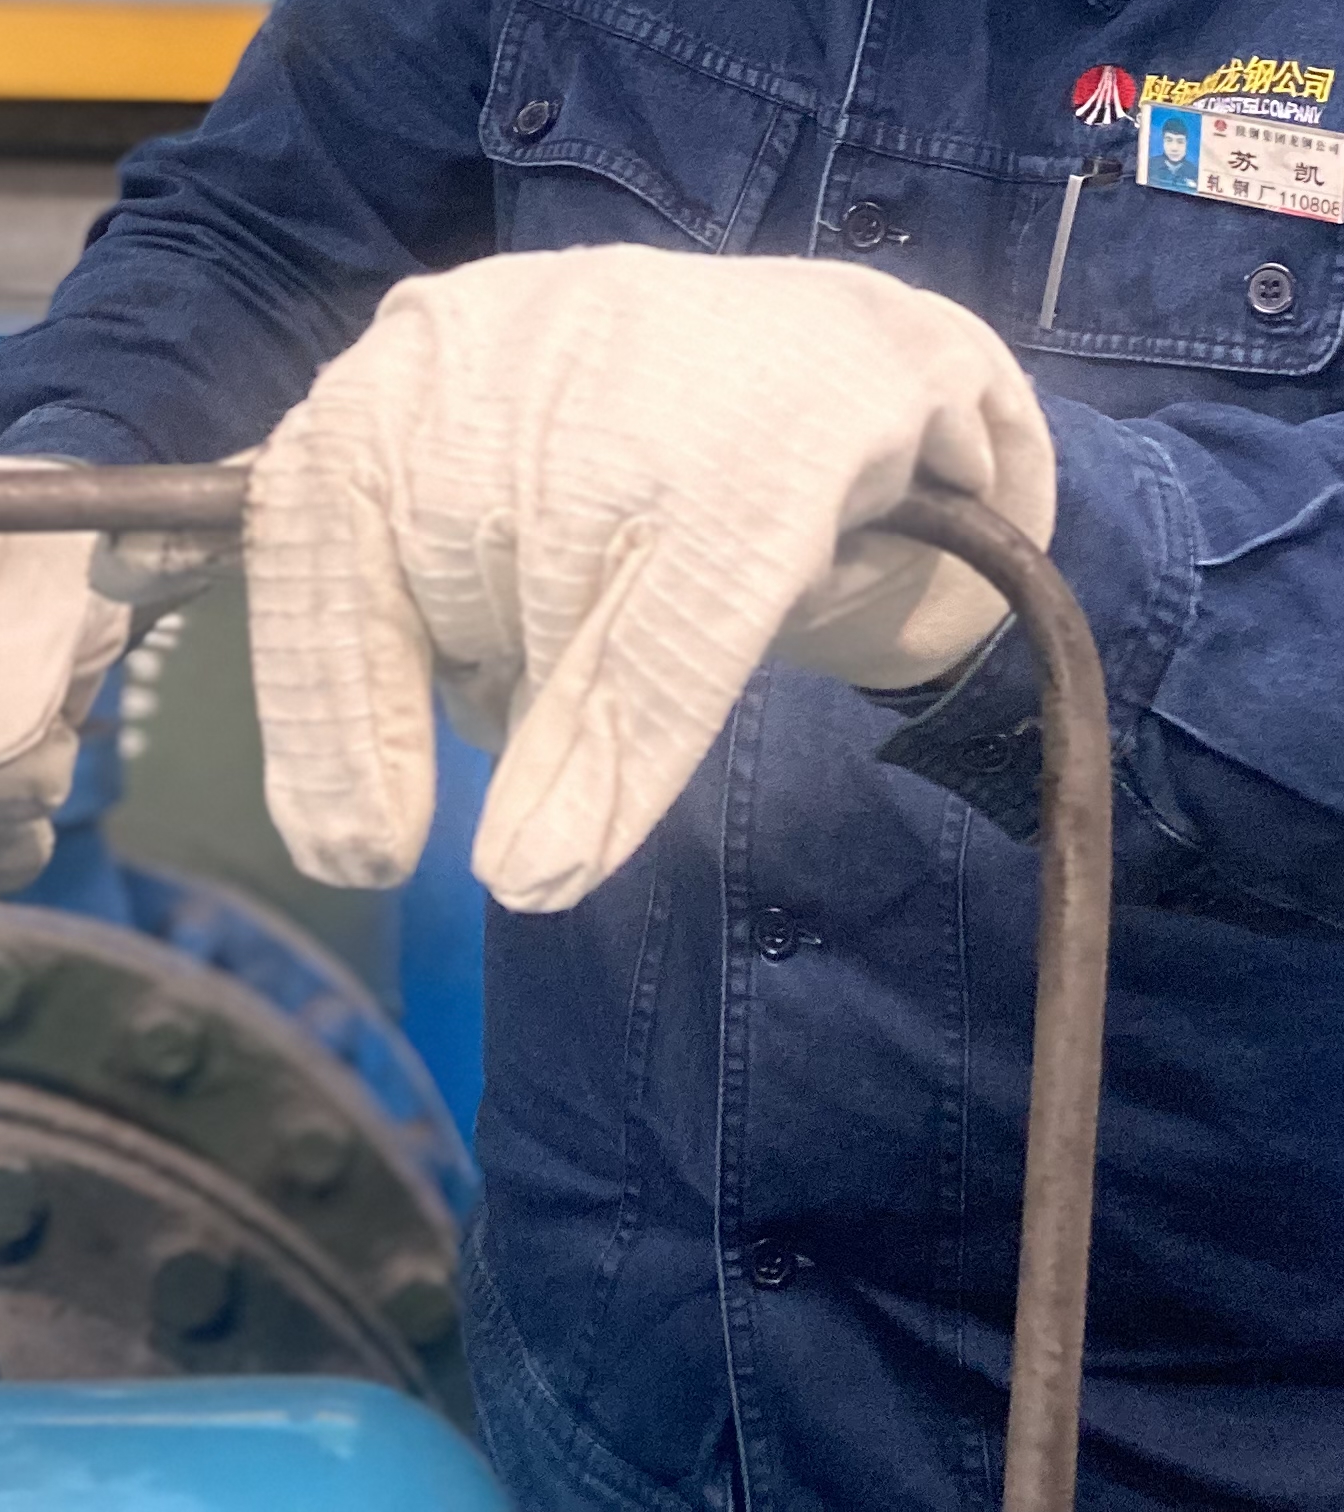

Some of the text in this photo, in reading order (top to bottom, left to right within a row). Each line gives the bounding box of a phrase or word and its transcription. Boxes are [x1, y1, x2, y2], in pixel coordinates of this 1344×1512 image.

[1141, 55, 1335, 105] 陕钢龙钢公司
